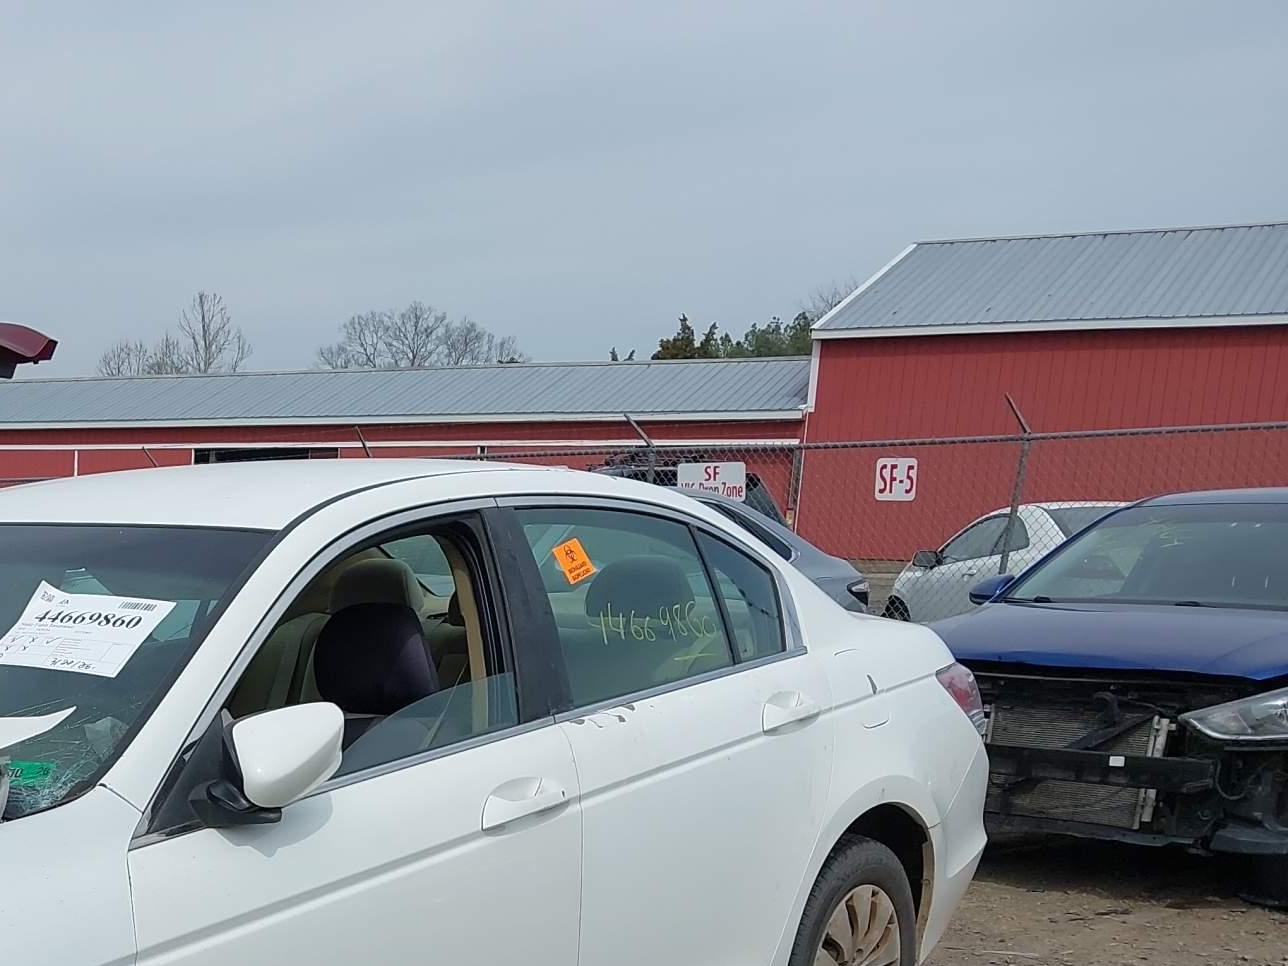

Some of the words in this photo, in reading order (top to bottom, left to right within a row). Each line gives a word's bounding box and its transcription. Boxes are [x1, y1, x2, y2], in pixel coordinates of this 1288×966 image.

[704, 465, 720, 481] SF
[878, 463, 915, 494] SF-5
[35, 609, 143, 630] 44669860
